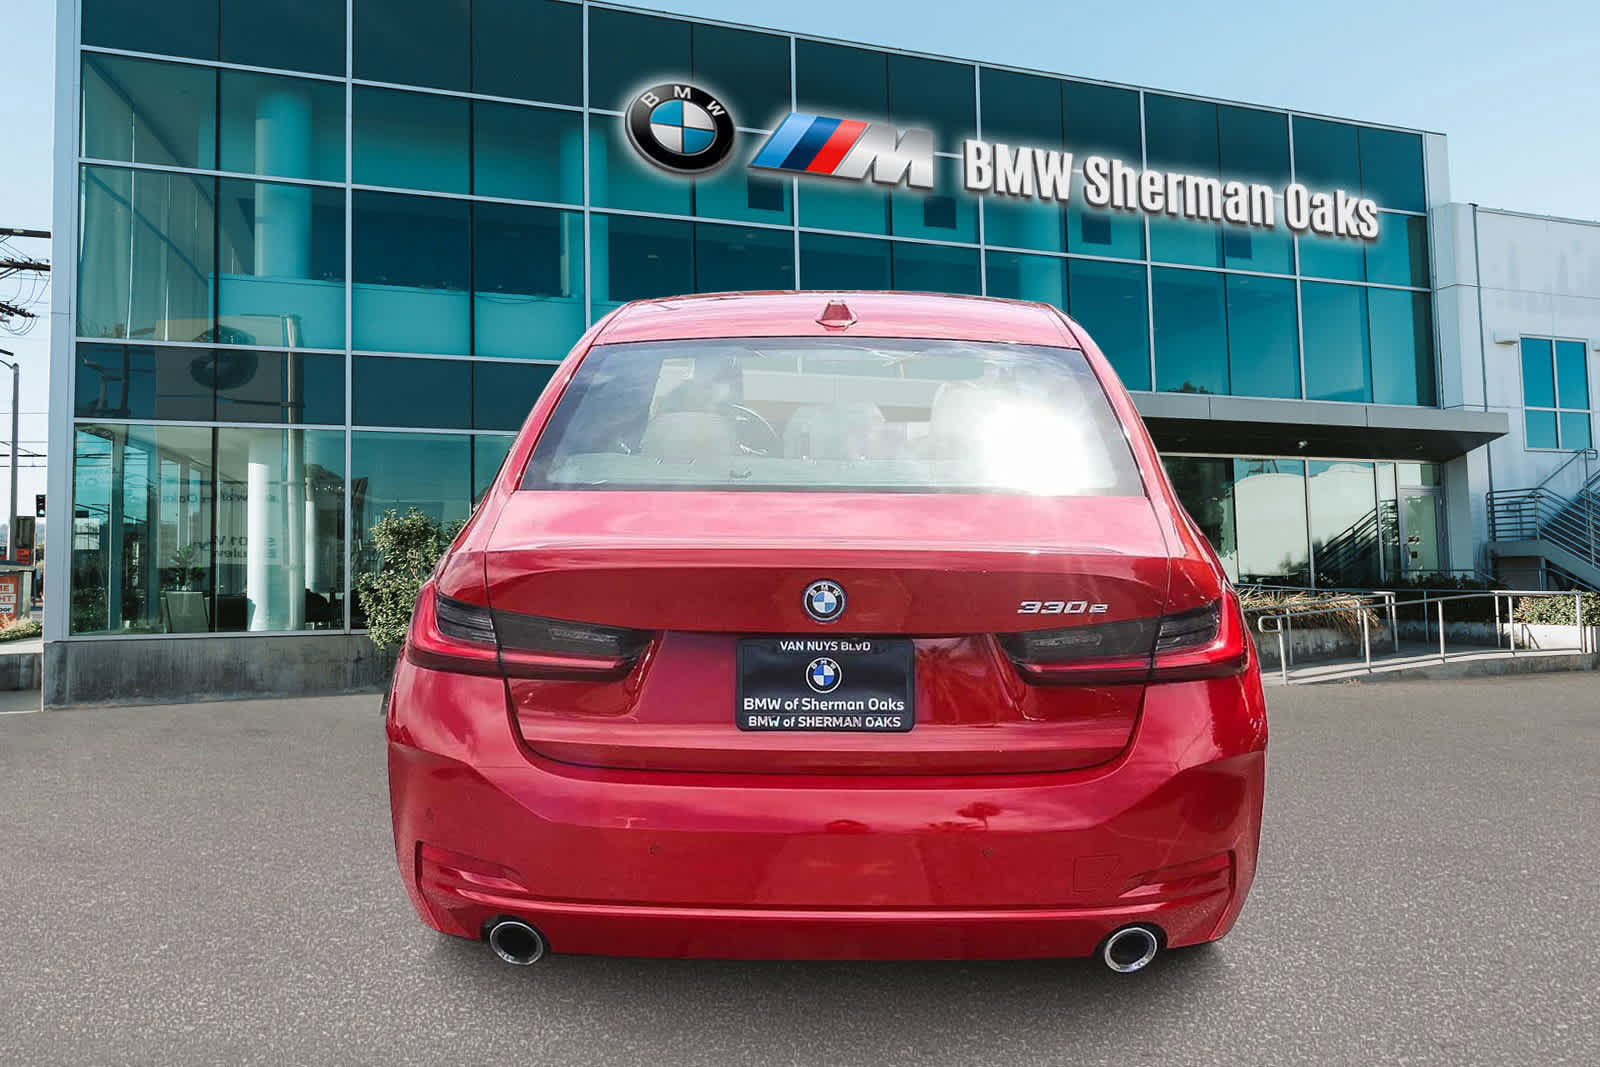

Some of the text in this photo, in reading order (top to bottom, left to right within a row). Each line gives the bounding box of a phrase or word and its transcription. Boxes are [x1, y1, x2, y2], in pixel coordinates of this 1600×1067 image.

[641, 85, 725, 117] BMW
[963, 139, 1380, 240] BMW Sherman Oaks
[809, 584, 840, 597] BMW
[1016, 600, 1109, 614] 330e
[780, 641, 804, 651] VAN
[807, 641, 838, 651] NUYS
[744, 697, 904, 711] BMW of Sherman Oaks
[748, 716, 901, 727] BMW of SHERMAN OAKS
